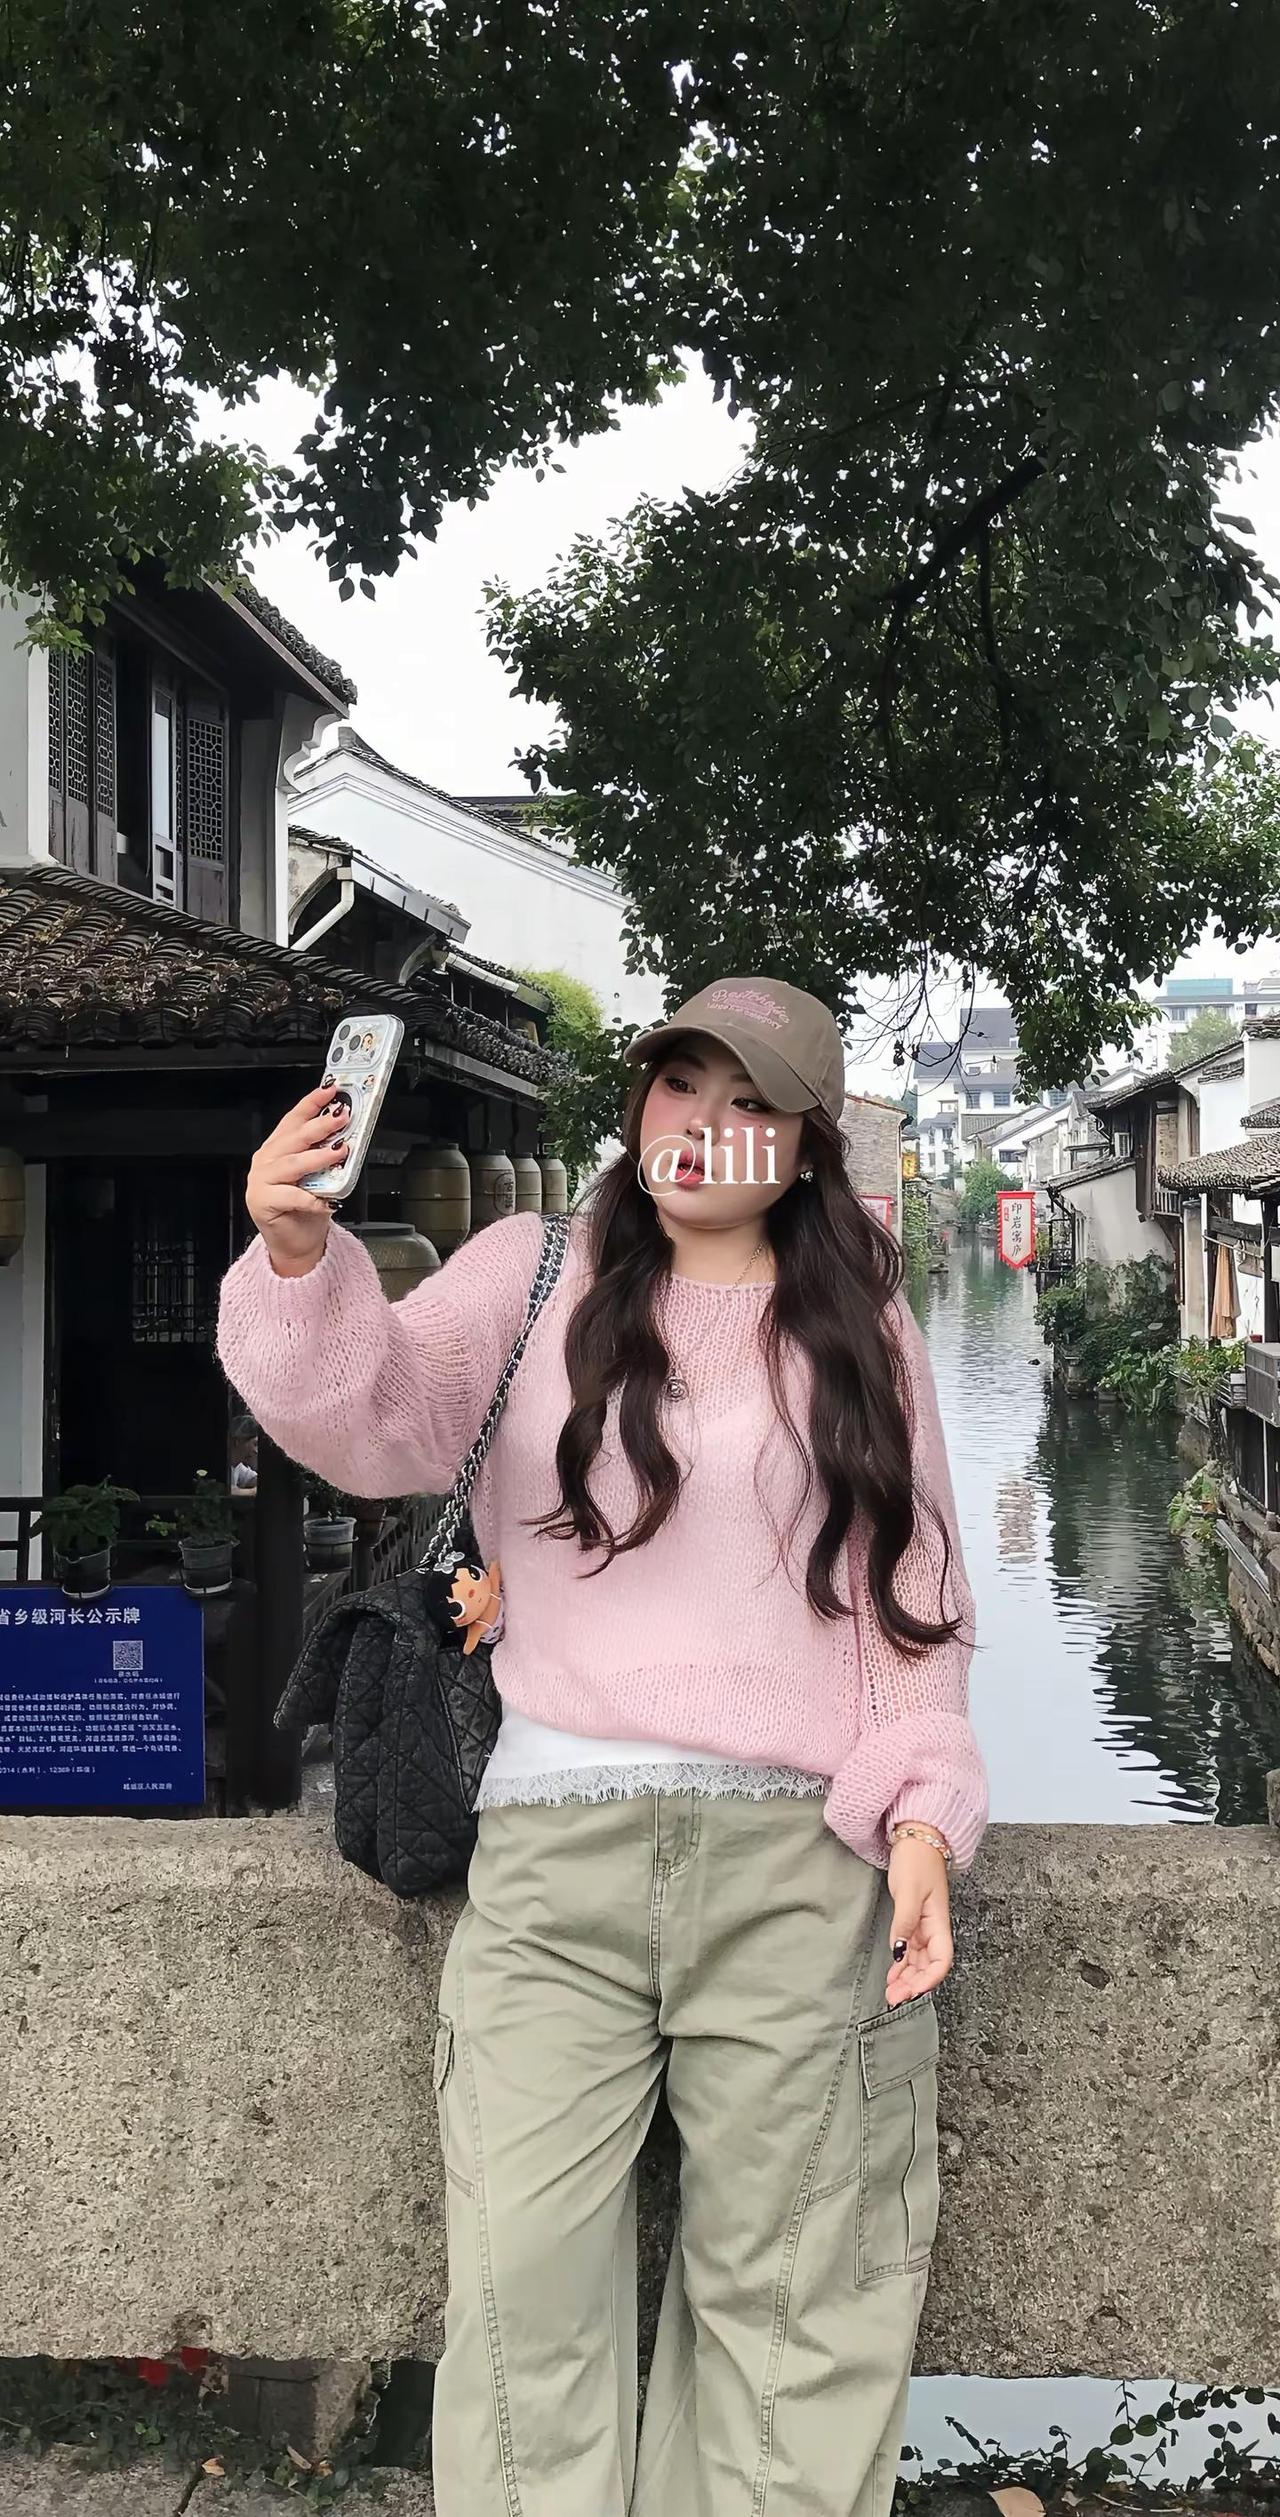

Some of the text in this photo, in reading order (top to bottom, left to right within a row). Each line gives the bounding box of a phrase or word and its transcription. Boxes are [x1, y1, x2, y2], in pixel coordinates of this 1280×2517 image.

[0, 1607, 141, 1625] 省乡级河长公示牌
